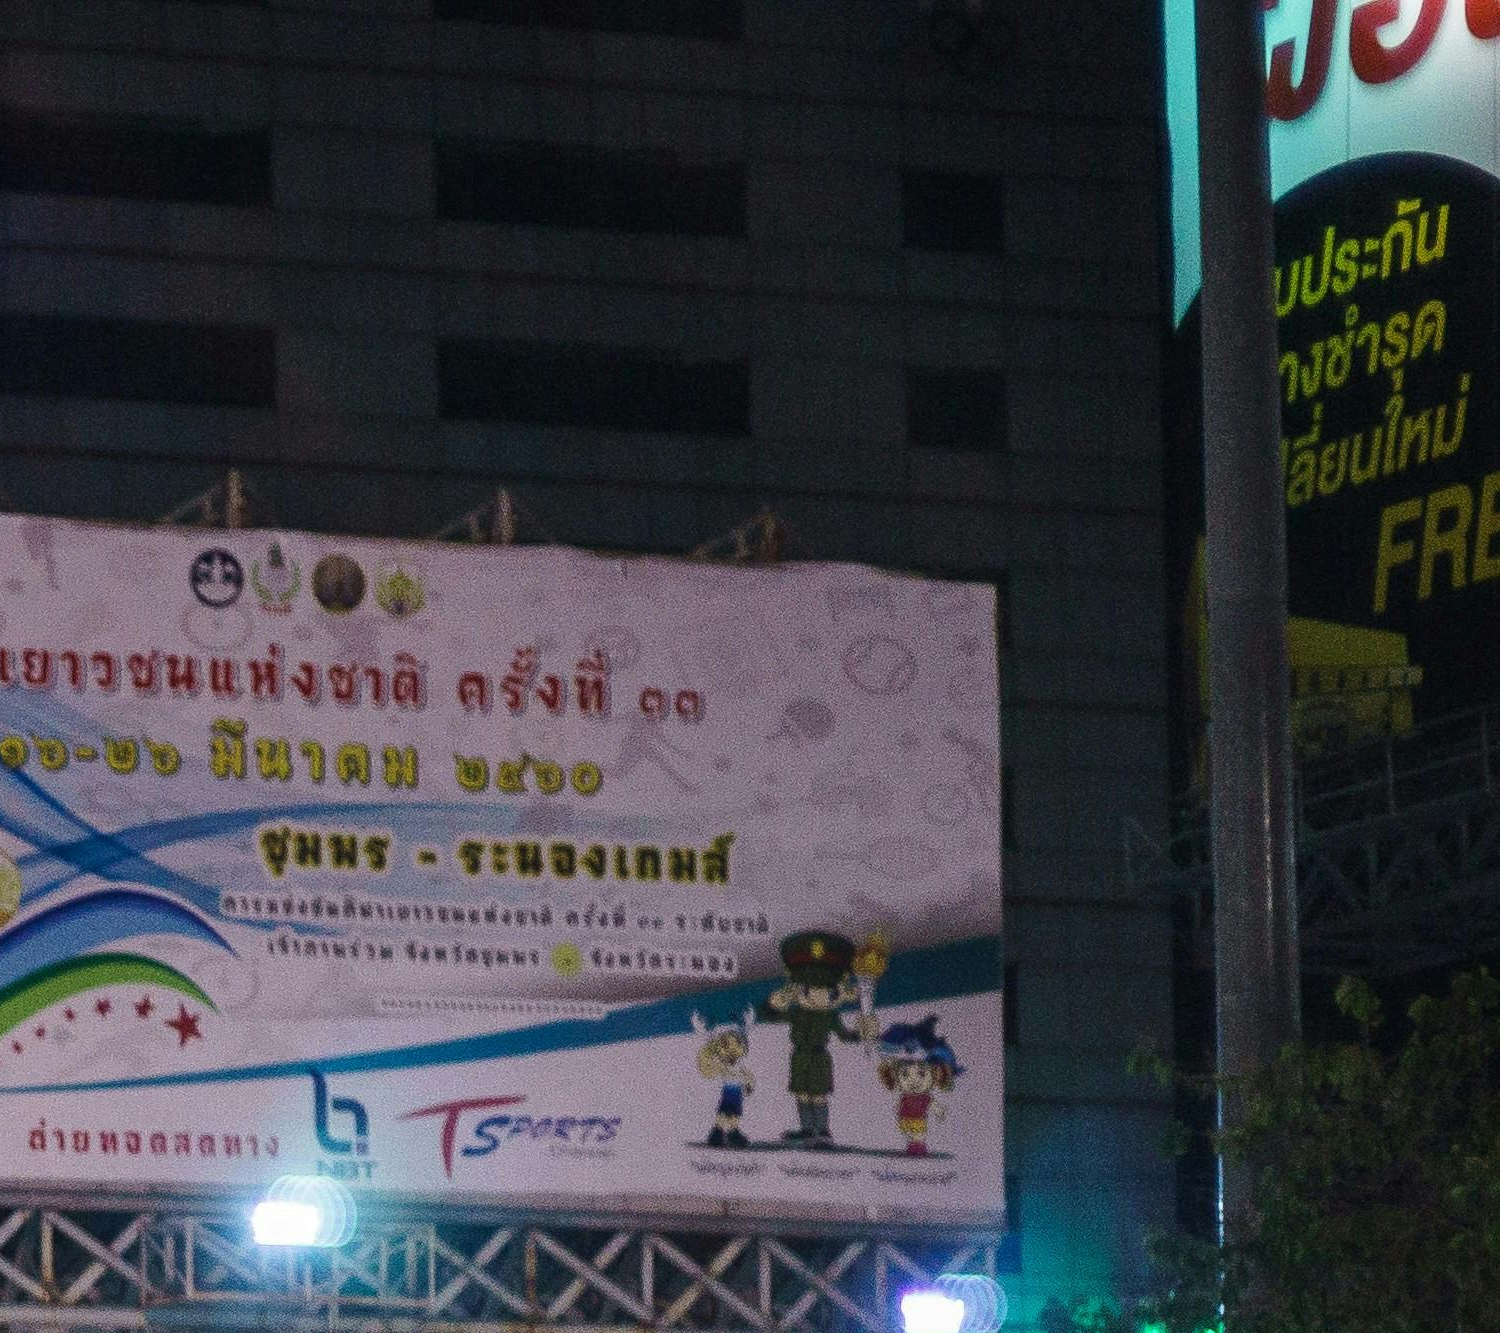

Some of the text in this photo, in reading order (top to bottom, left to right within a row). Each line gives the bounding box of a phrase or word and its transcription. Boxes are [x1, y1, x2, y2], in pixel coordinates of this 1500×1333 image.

[1273, 198, 1449, 318] บประกัน
[1277, 299, 1447, 404] างชำรุด
[1280, 371, 1471, 507] ลี่ยนใหม่
[457, 646, 611, 716] ครั้งที่
[209, 716, 421, 789] มีนาคม
[259, 825, 392, 880] ชุมพร
[457, 832, 737, 886] ระนองเกมส์
